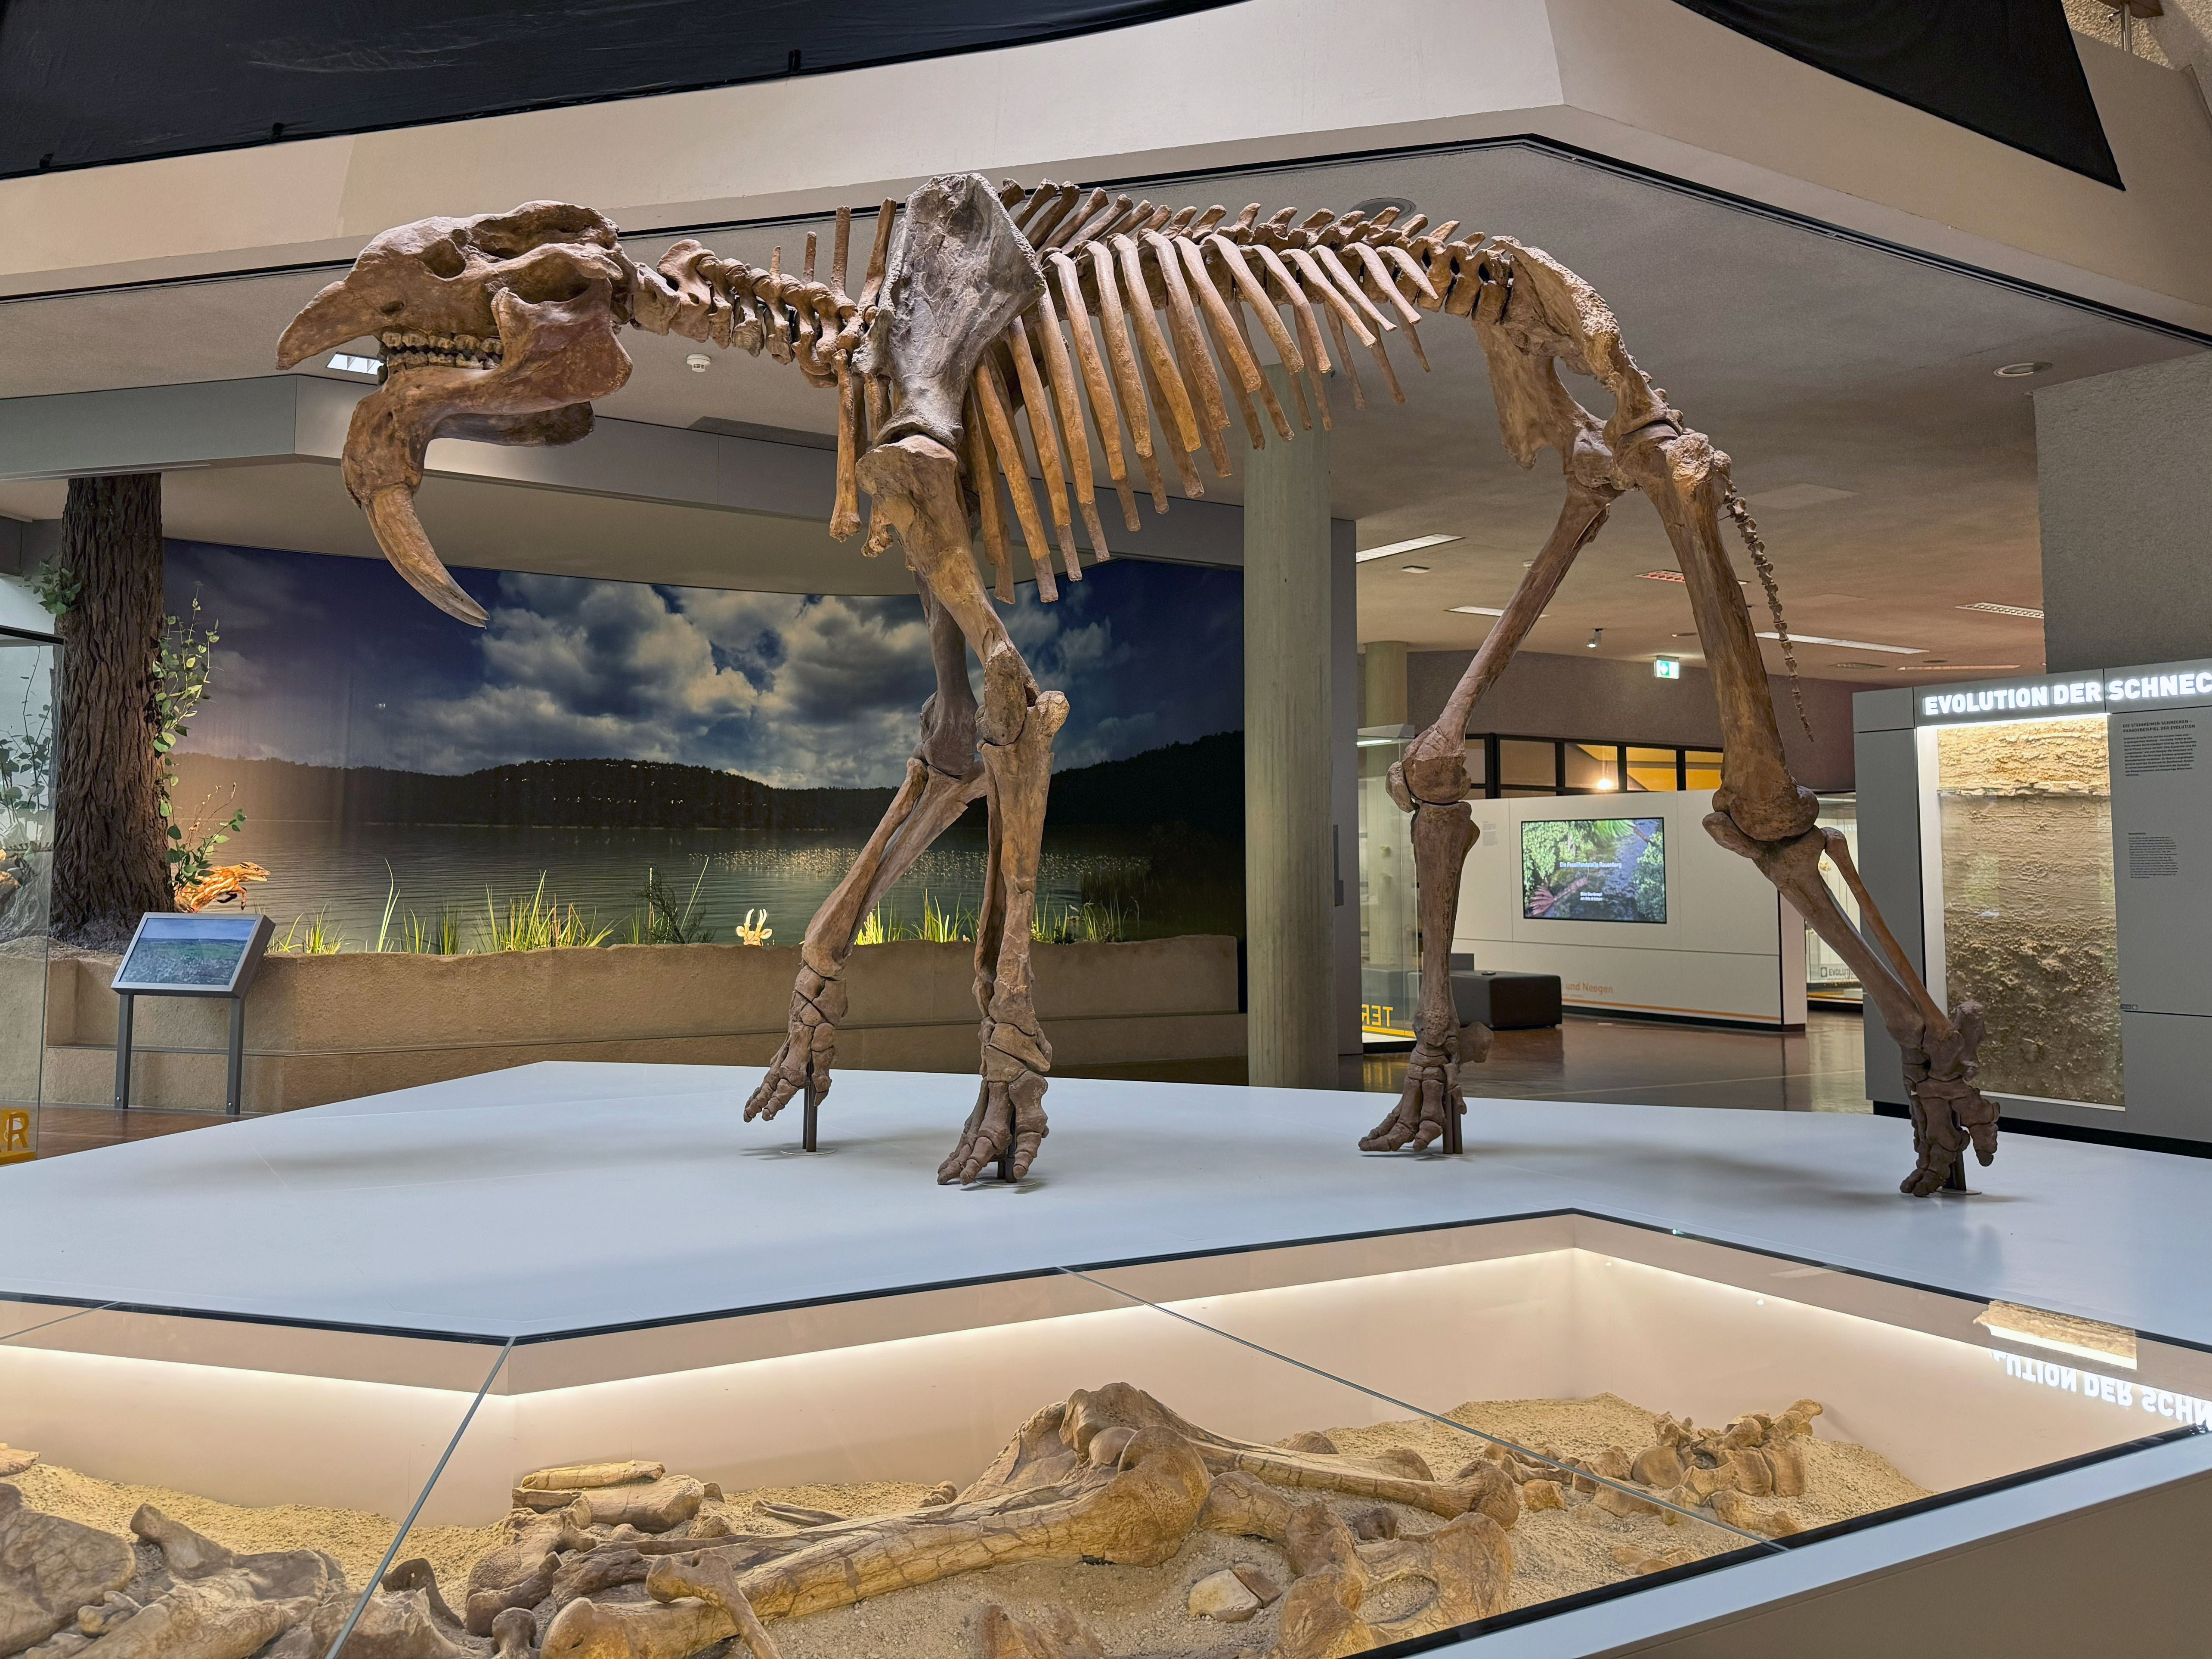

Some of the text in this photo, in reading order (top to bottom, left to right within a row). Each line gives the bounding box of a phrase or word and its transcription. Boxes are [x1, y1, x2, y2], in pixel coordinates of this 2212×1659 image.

[1925, 672, 2212, 715] EVOLUTION DER SCHNEC
[1829, 968, 1853, 976] EVOLUTI
[1583, 982, 1613, 994] Neogen
